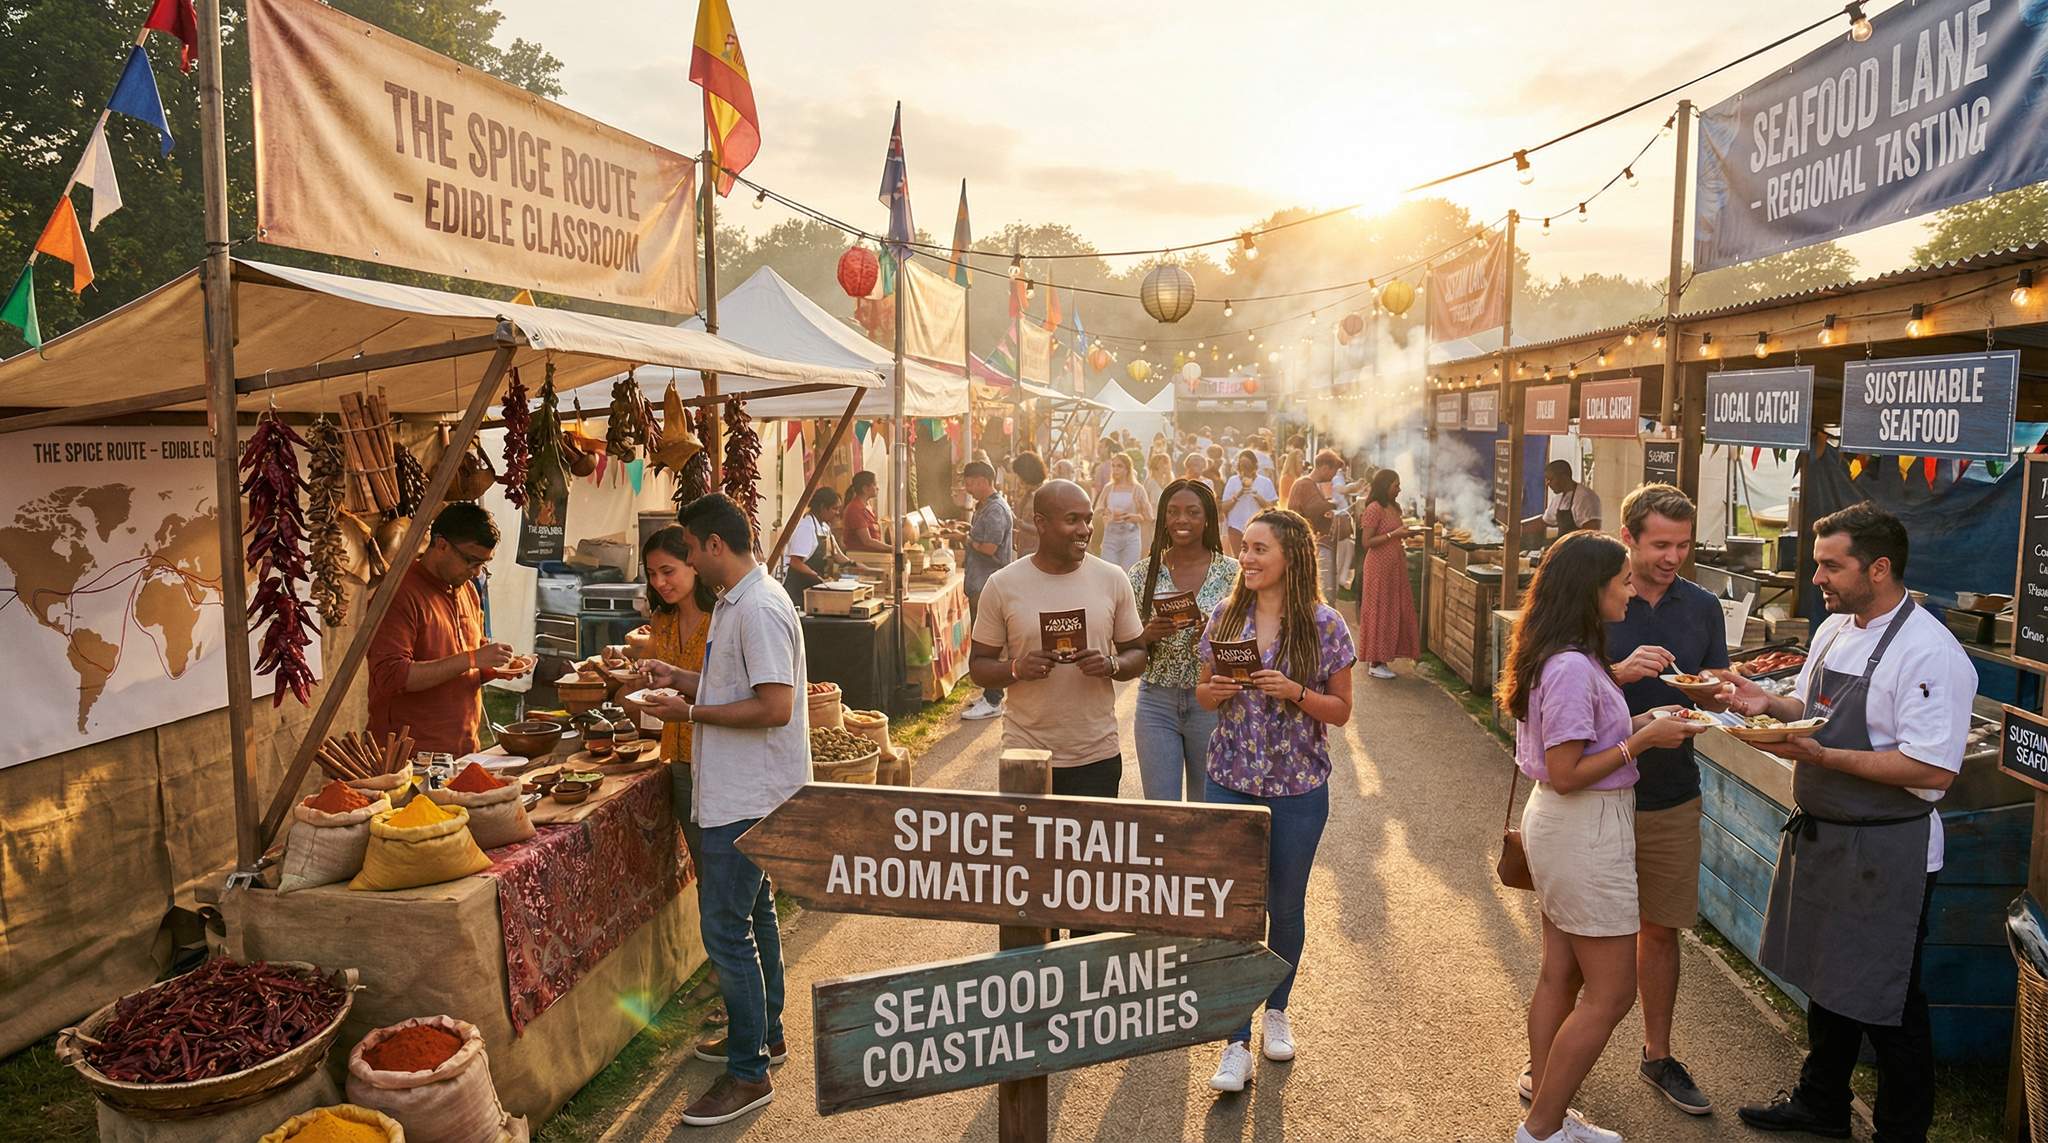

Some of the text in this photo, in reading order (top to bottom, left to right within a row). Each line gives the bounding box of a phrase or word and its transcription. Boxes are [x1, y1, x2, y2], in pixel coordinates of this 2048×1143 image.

[1750, 0, 1991, 174] SEAFOOD LANE
[384, 80, 640, 222] THE SPICE ROUTE
[1767, 145, 1866, 222] REGIONAL
[1875, 96, 1991, 186] TASTING
[425, 178, 514, 247] EDIBLE
[522, 203, 641, 274] CLASSROOM
[1587, 396, 1632, 419] LOCAL CATCH
[1714, 391, 1800, 424] LOCAL CATCH
[1864, 367, 1986, 405] SUSTAINABLE
[33, 443, 62, 463] THE
[65, 442, 103, 462] SPICE
[107, 441, 147, 461] ROUTE
[161, 440, 201, 459] EDIBLE
[1879, 408, 1960, 444] SEAFOOD
[2016, 746, 2048, 773] SEAFO
[894, 807, 1165, 867] SPICE TRAIL:
[826, 854, 1235, 919] AROMATIC JOURNEY
[874, 944, 1189, 1038] SEAFOOD LANE:
[862, 989, 1199, 1087] COASTAL STORIES
